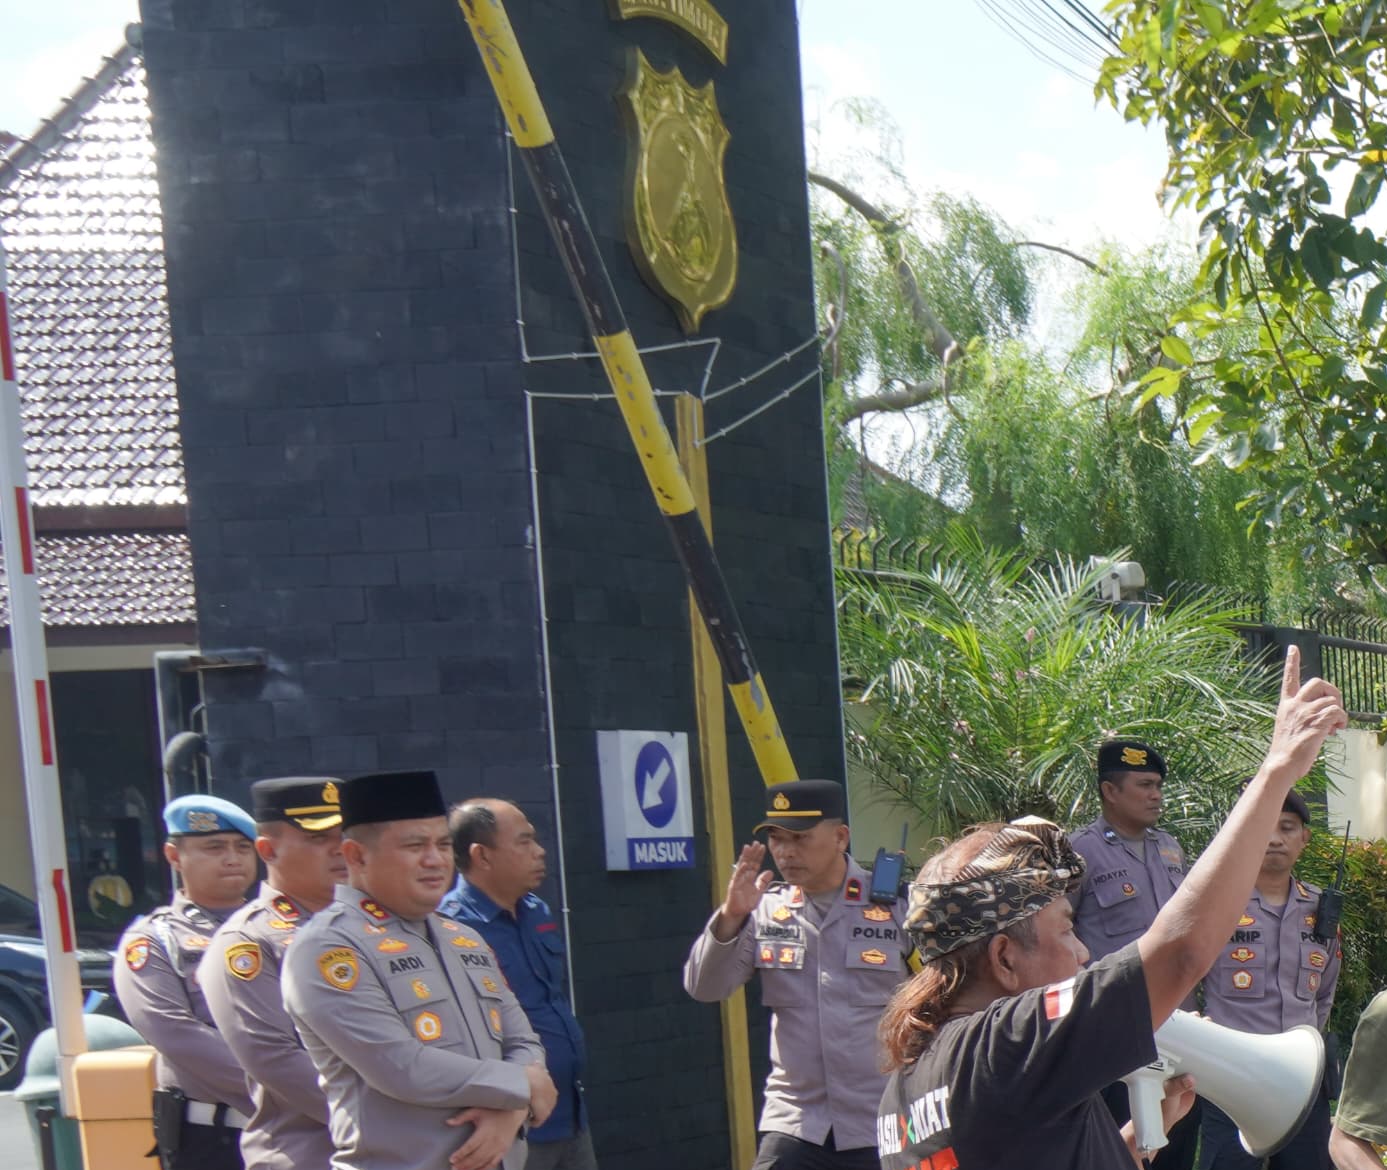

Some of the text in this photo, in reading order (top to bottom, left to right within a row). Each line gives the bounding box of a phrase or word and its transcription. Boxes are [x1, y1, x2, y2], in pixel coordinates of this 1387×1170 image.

[634, 841, 688, 863] MASUK
[853, 927, 897, 940] POLRI
[389, 955, 425, 975] ARDI
